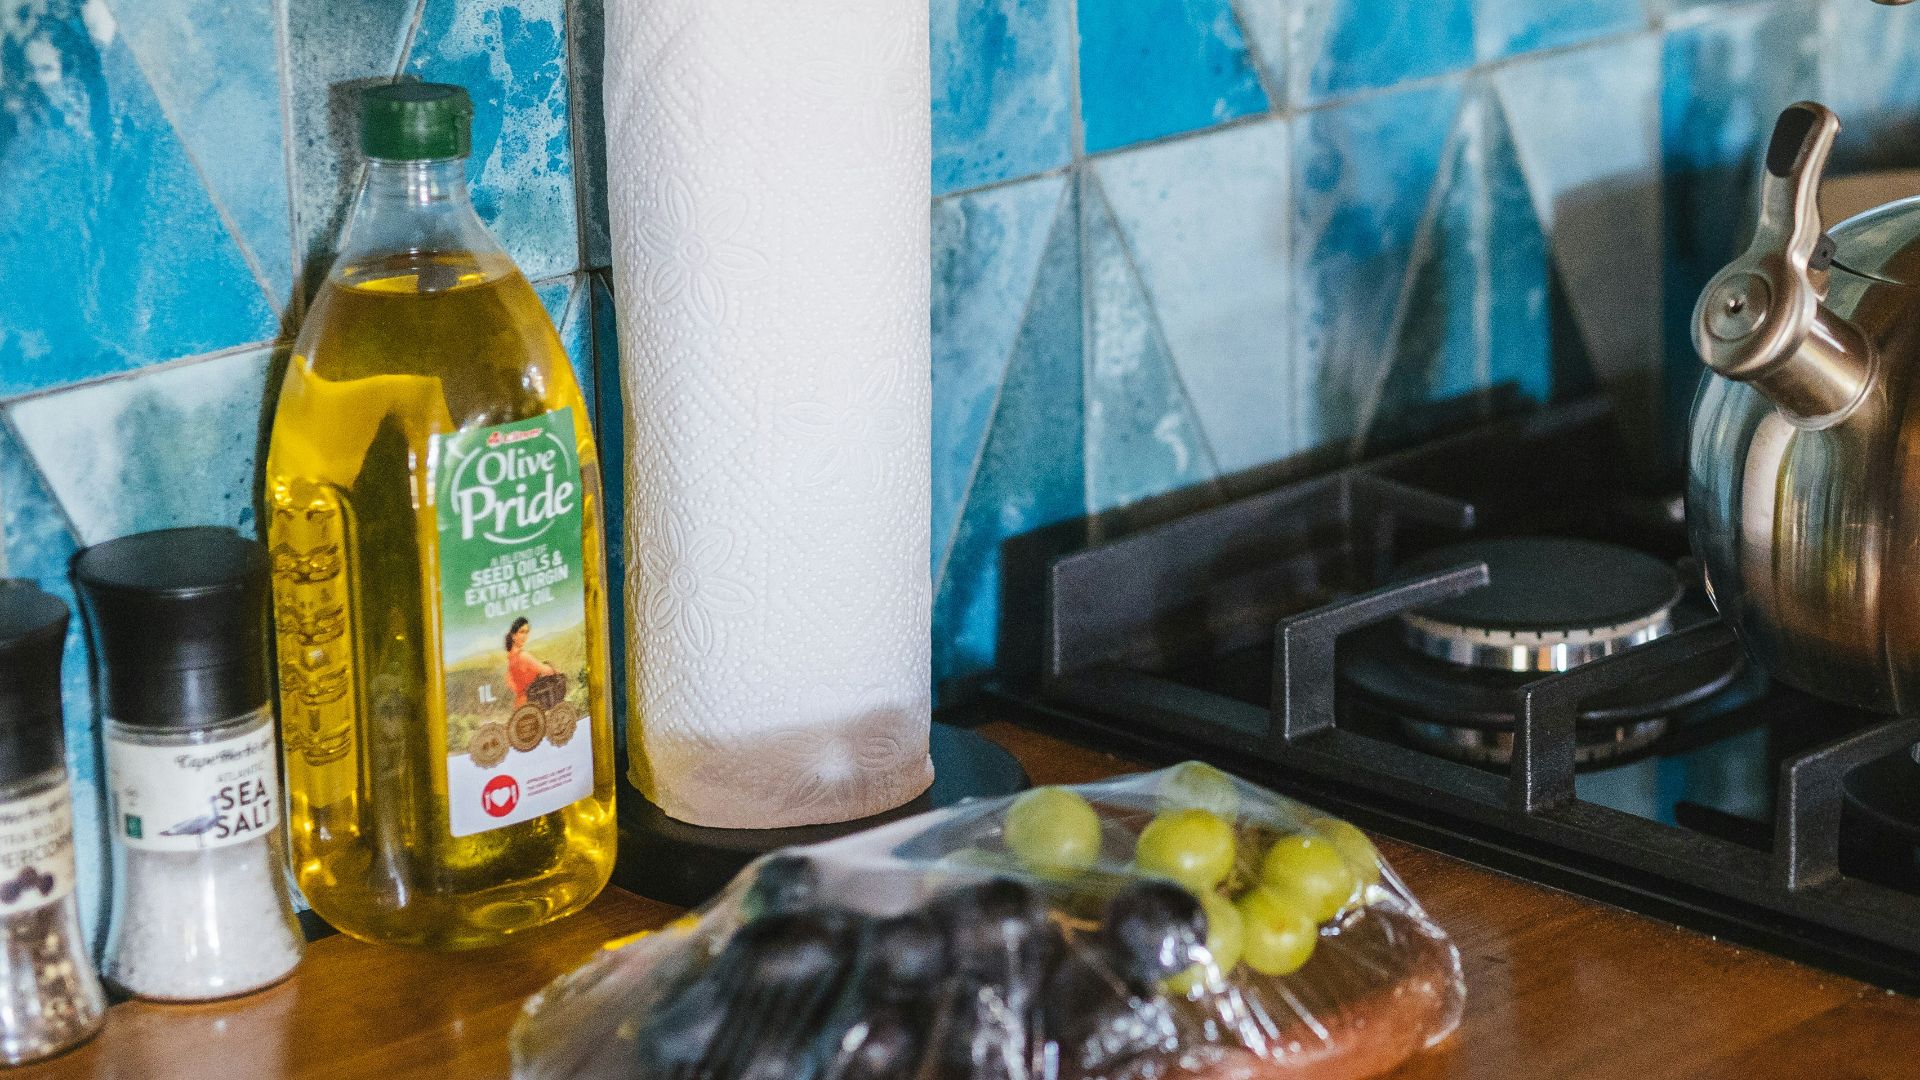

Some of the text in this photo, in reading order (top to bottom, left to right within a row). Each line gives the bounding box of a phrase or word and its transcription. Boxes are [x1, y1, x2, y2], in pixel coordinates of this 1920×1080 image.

[476, 448, 556, 486] Olive
[457, 473, 574, 540] Pride
[465, 564, 569, 606] EXTRA VIRGIN
[471, 549, 564, 587] SEED OILS &
[484, 587, 555, 618] OLIVE OIL
[478, 683, 497, 703] 1L
[220, 778, 267, 810] SEA
[215, 799, 271, 839] SALT
